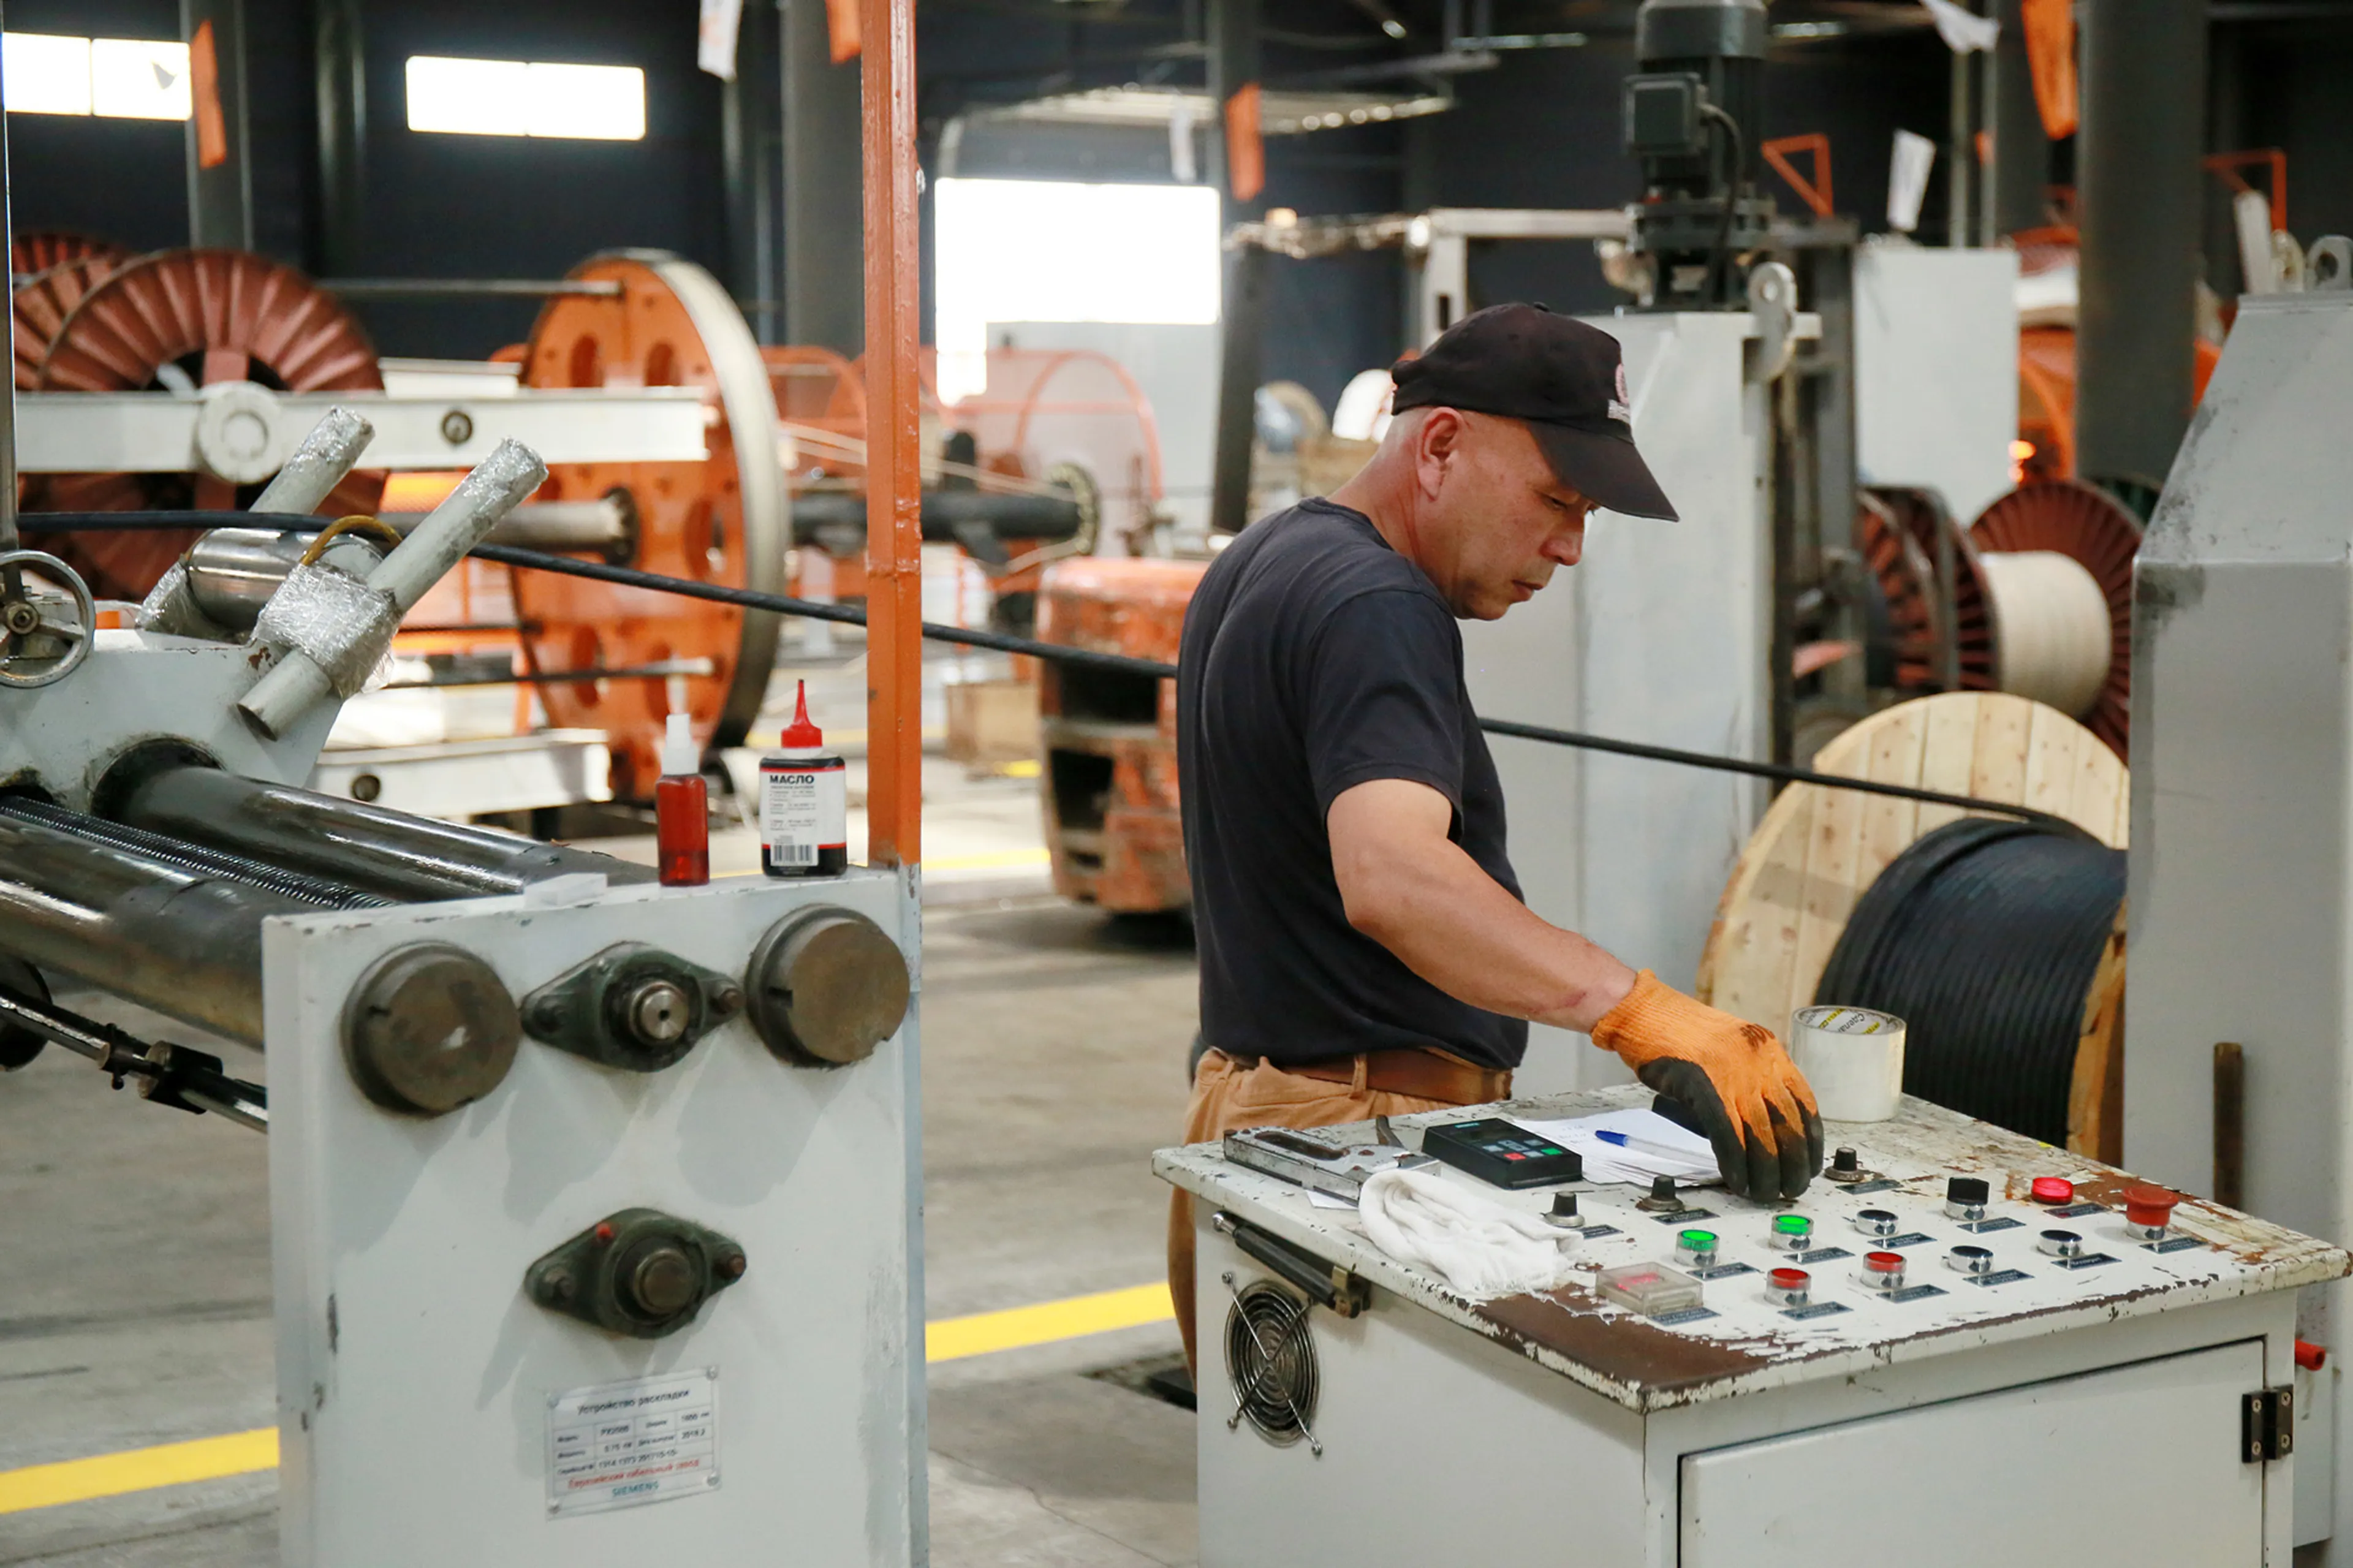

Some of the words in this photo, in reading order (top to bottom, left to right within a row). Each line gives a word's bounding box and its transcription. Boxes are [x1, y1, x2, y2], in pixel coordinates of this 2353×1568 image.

[769, 775, 814, 784] МАСЛО
[578, 1399, 635, 1415] Устройство
[638, 1390, 690, 1406] раскладки
[612, 1481, 659, 1496] SIEMENS
